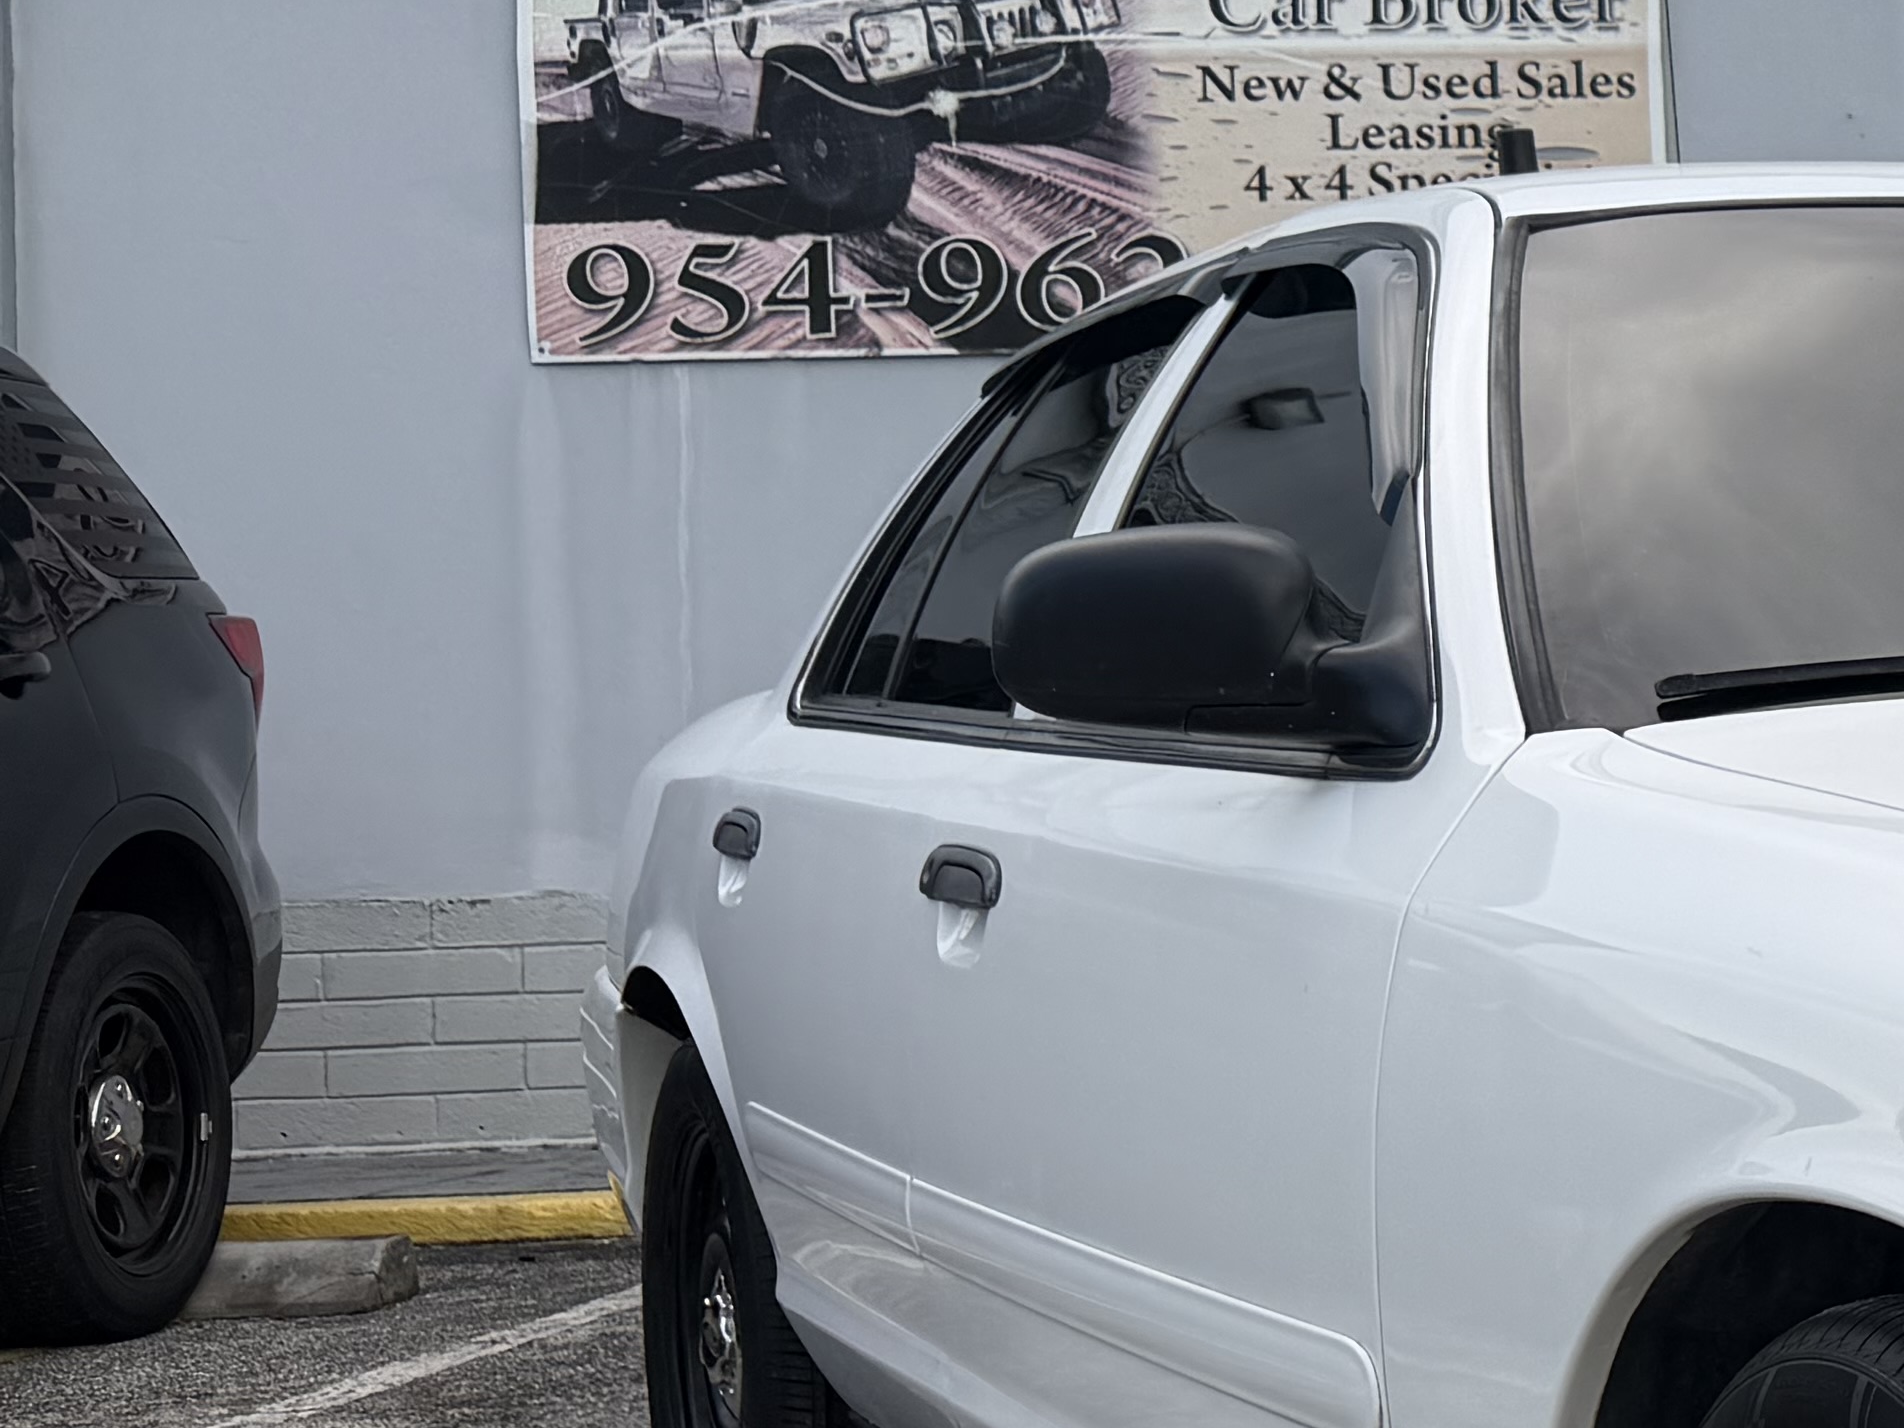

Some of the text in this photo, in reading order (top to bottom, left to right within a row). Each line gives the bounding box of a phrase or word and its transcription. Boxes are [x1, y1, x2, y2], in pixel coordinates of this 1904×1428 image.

[1195, 59, 1637, 103] New & Used Sales
[1243, 164, 1273, 203] 4
[1285, 175, 1314, 202] x
[1324, 163, 1353, 202] 4
